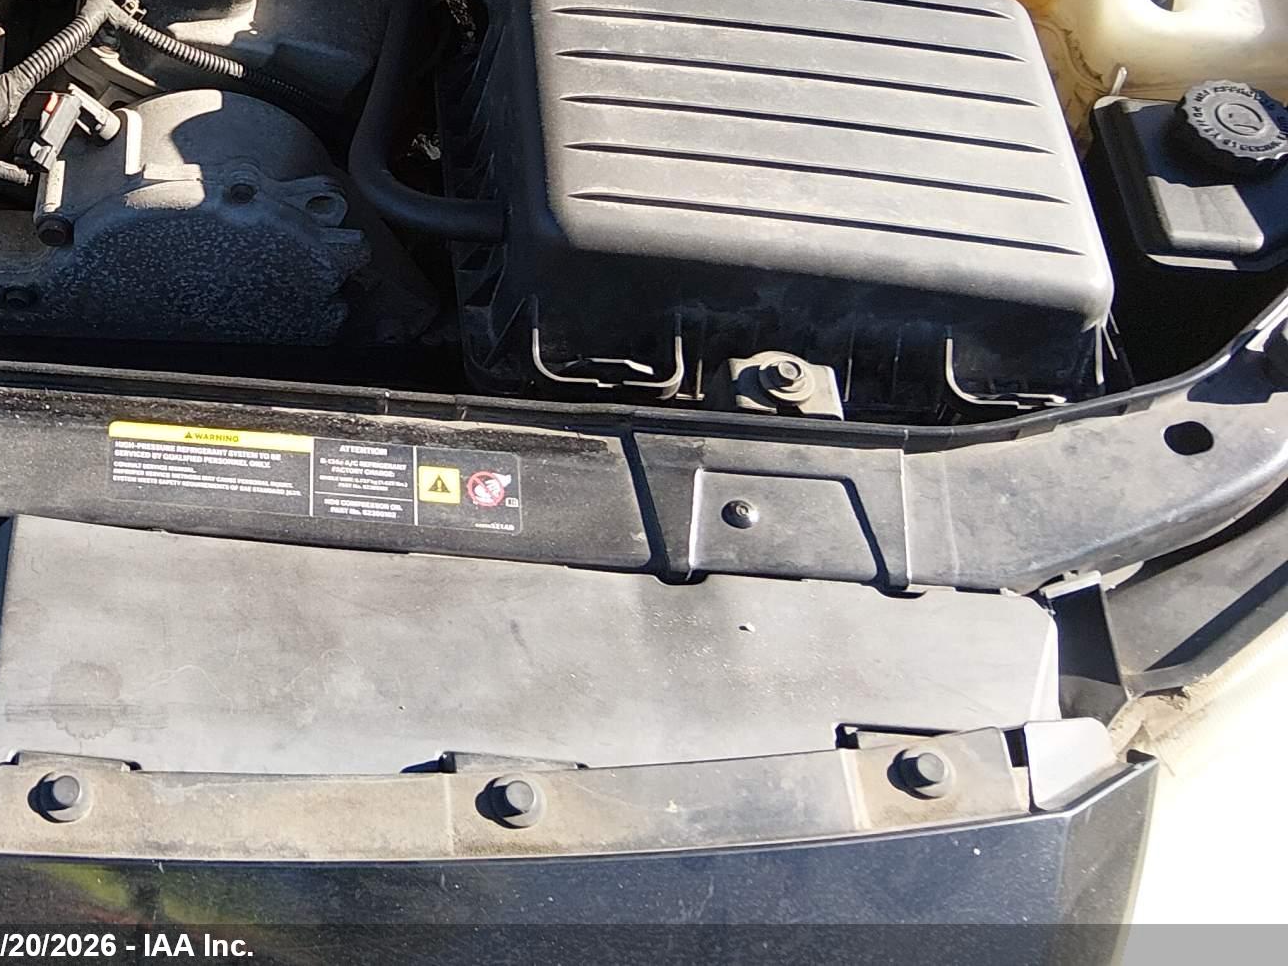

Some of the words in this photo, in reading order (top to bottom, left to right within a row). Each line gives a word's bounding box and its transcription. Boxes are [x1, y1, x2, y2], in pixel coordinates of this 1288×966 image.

[194, 433, 240, 443] WARNING
[339, 444, 387, 456] ATTENTION
[114, 449, 151, 458] SERVICED
[162, 452, 202, 462] QUALIFIED
[203, 455, 248, 466] PERSONNEL
